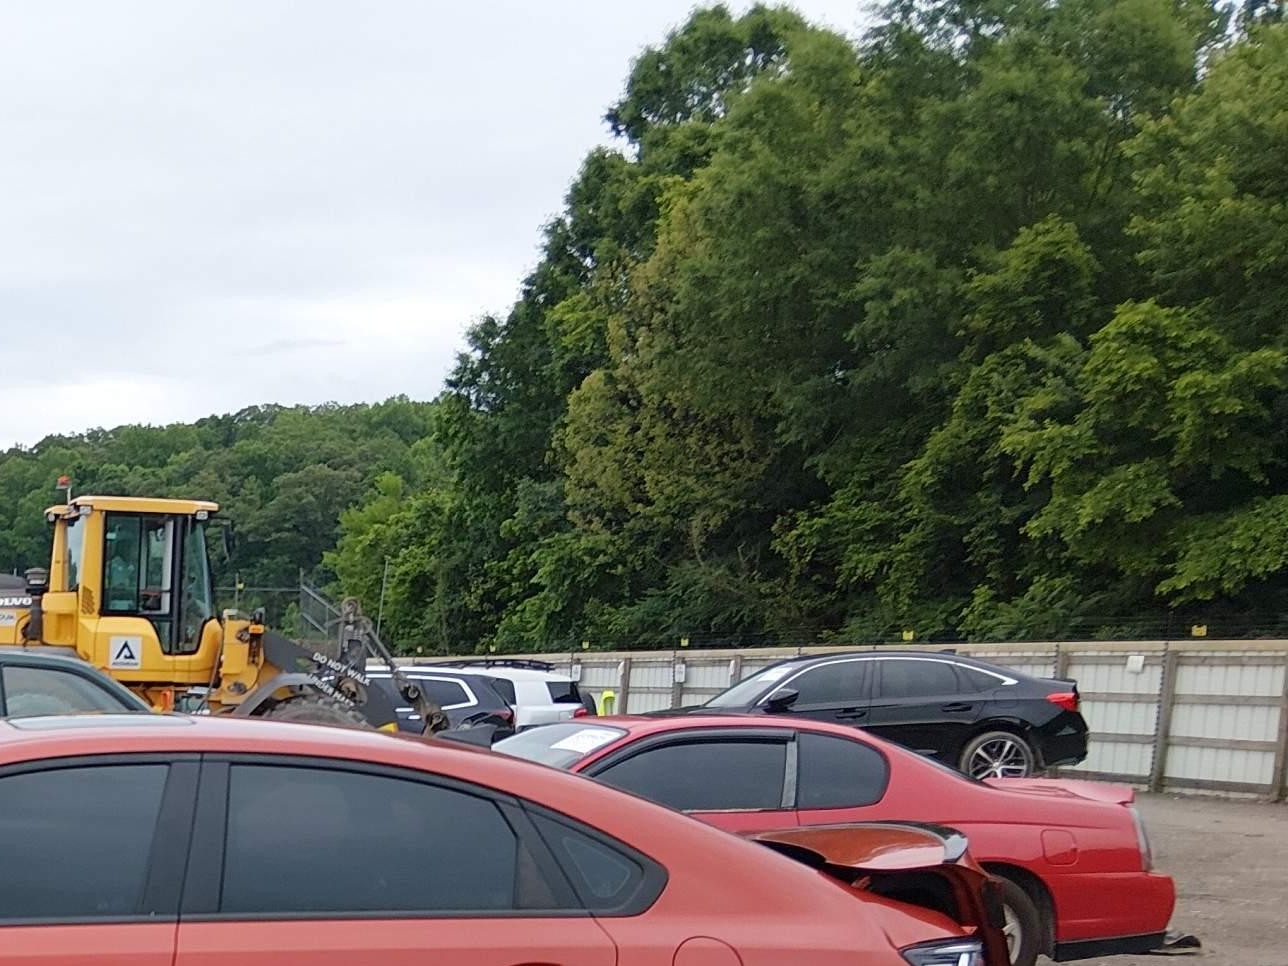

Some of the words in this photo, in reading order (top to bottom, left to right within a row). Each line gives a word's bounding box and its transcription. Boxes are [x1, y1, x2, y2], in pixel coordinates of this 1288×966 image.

[312, 652, 328, 664] DO
[326, 659, 348, 673] NOT
[347, 669, 370, 686] WALK
